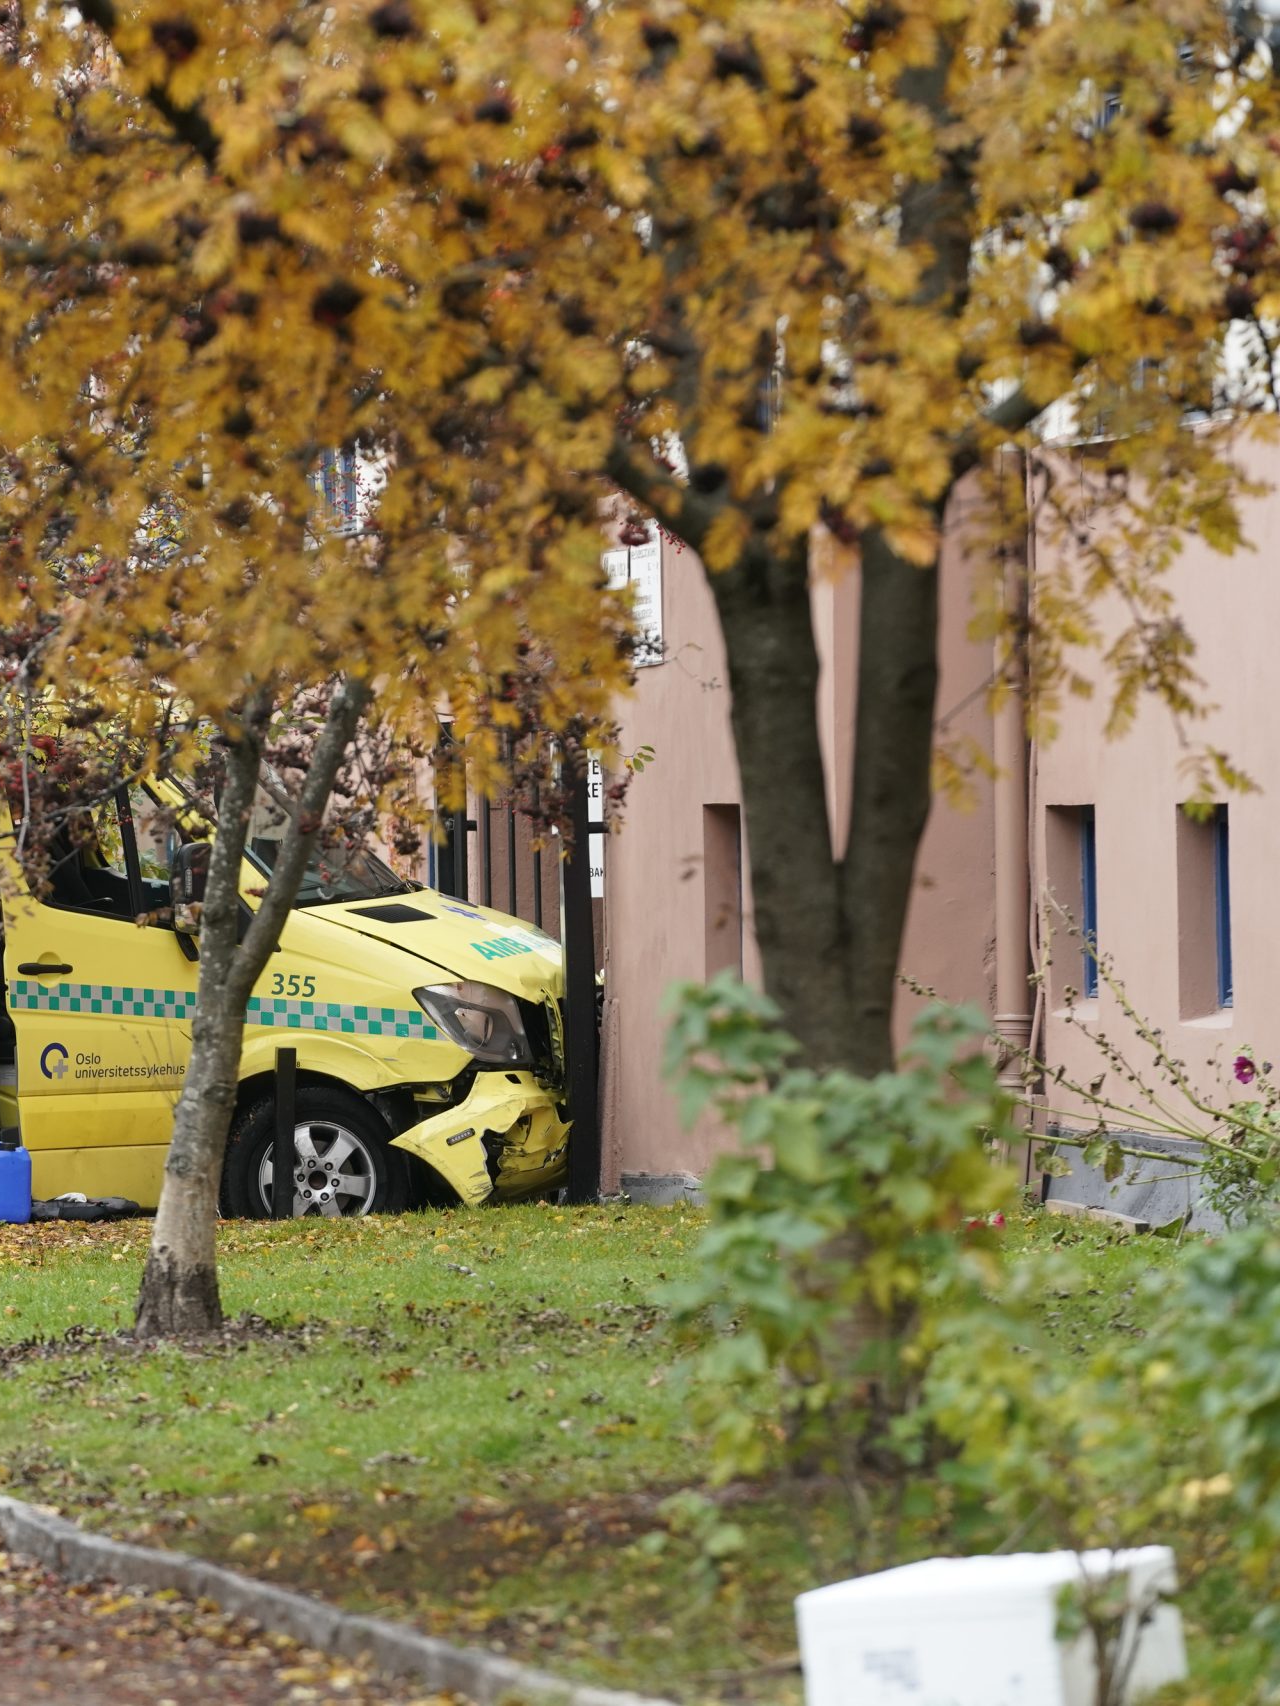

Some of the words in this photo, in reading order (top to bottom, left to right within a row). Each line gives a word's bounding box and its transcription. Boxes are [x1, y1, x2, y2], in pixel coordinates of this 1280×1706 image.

[271, 972, 316, 998] 355
[75, 1052, 101, 1065] Oslo
[75, 1063, 186, 1079] universitetssykehus
